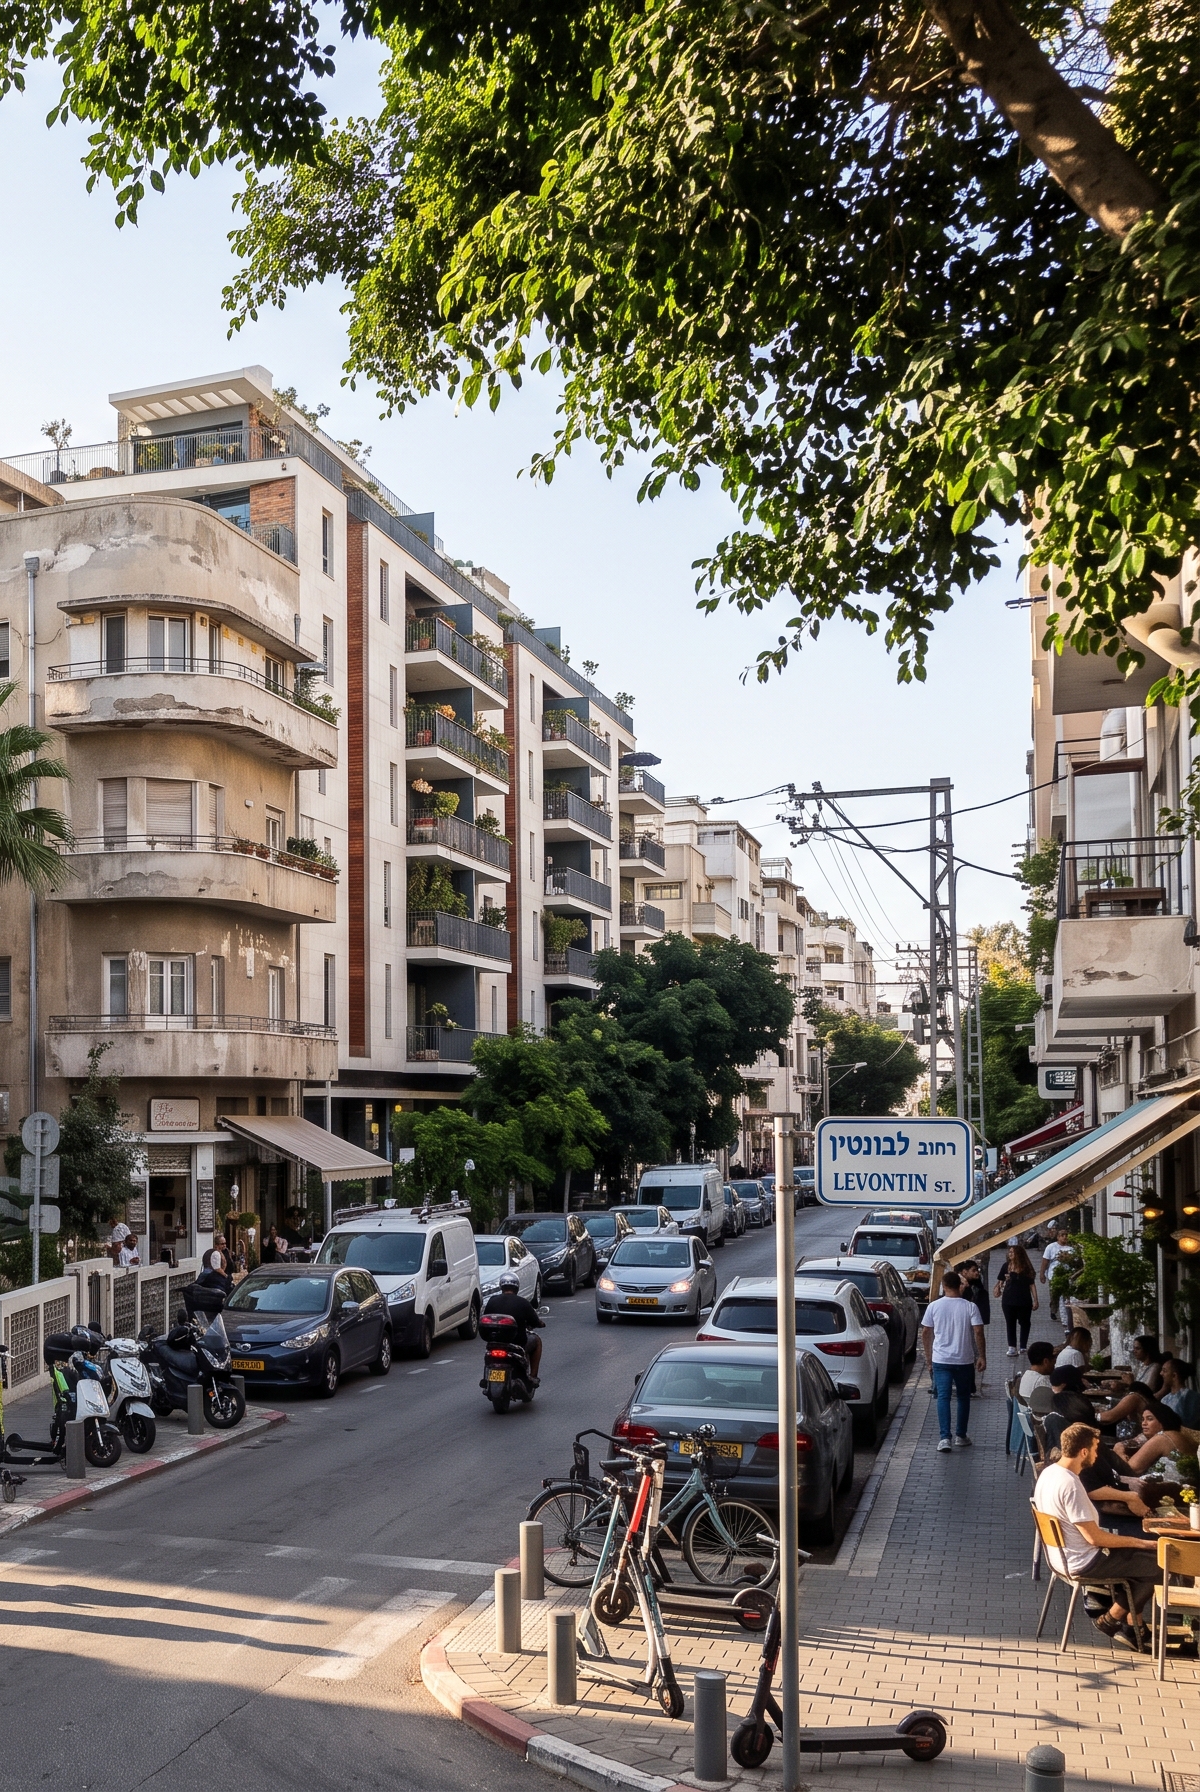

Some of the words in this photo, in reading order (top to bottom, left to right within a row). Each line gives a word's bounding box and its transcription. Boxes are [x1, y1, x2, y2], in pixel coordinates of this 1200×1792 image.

[829, 1130, 910, 1162] לבונטין
[917, 1141, 956, 1156] רחוב
[833, 1172, 928, 1192] LEVONTIN
[934, 1180, 956, 1193] ST.
